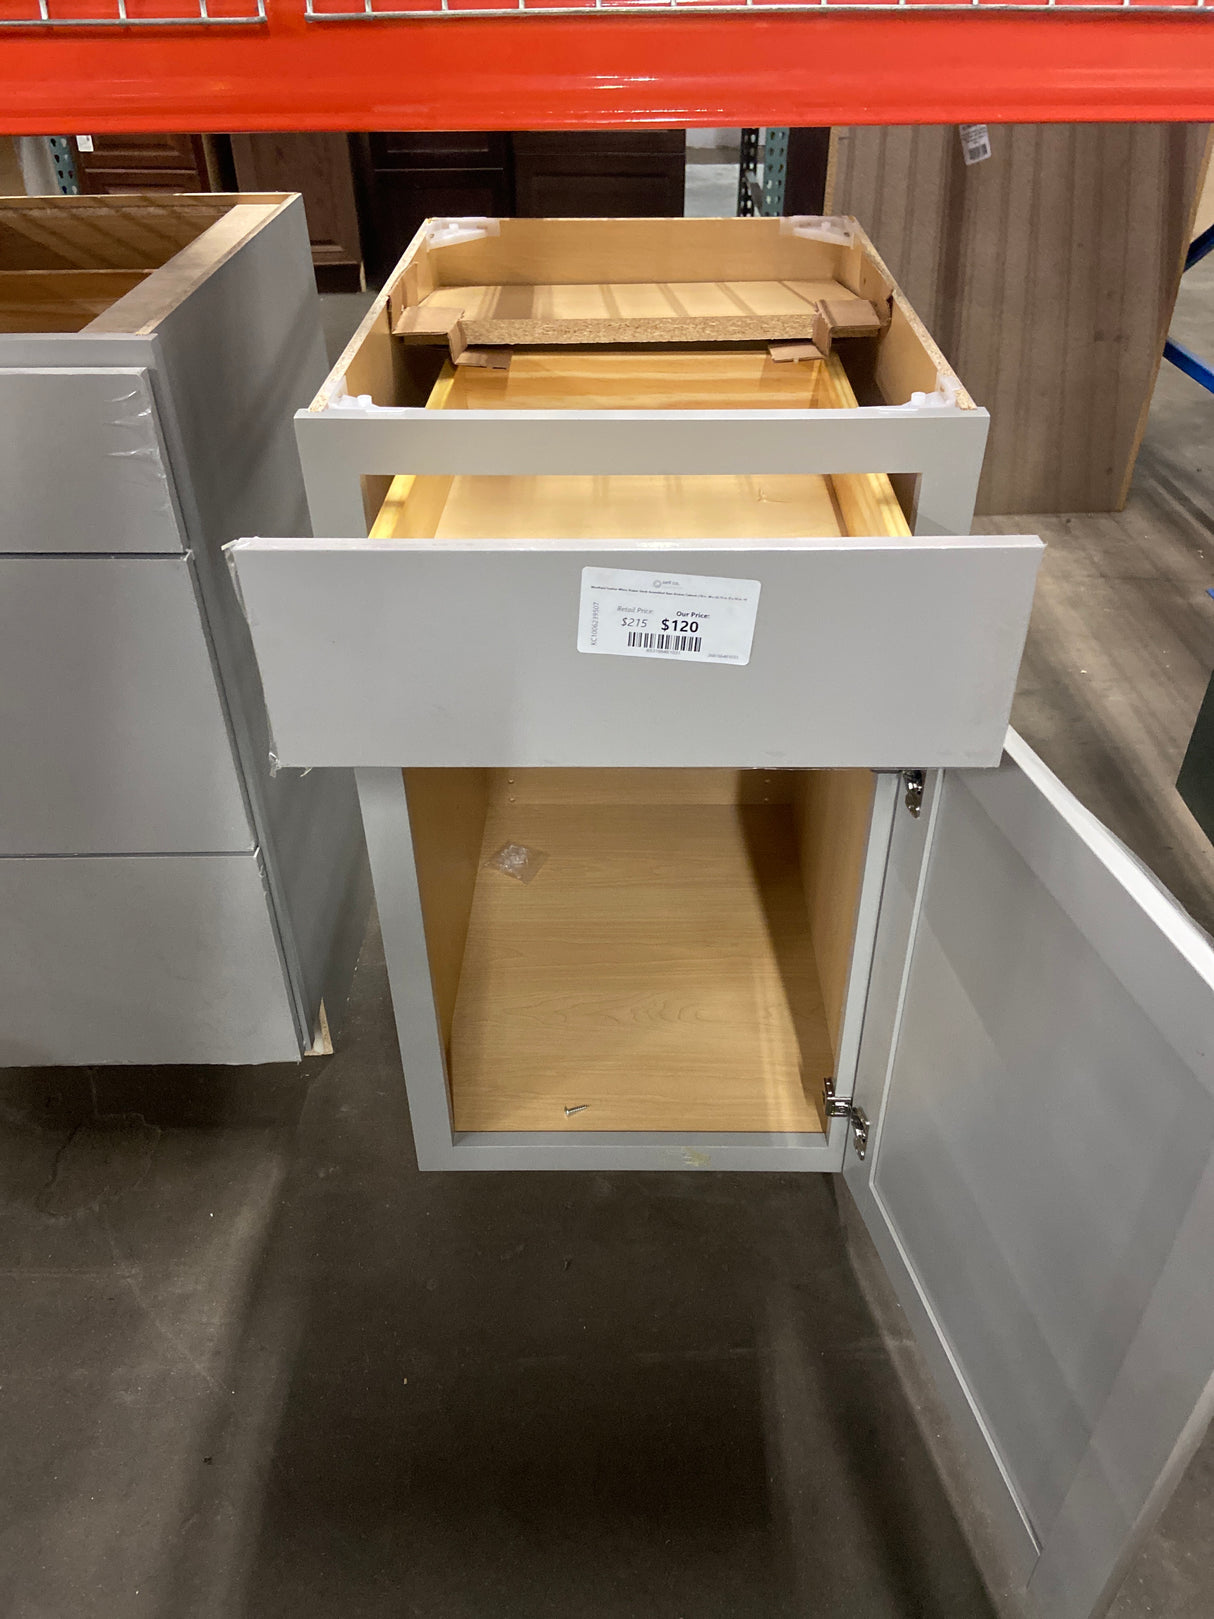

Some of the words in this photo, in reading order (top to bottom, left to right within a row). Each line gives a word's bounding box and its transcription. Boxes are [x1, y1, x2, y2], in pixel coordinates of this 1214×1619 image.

[617, 605, 636, 613] Retail
[690, 611, 710, 619] Price:
[621, 617, 648, 628] $215
[661, 617, 699, 633] $120
